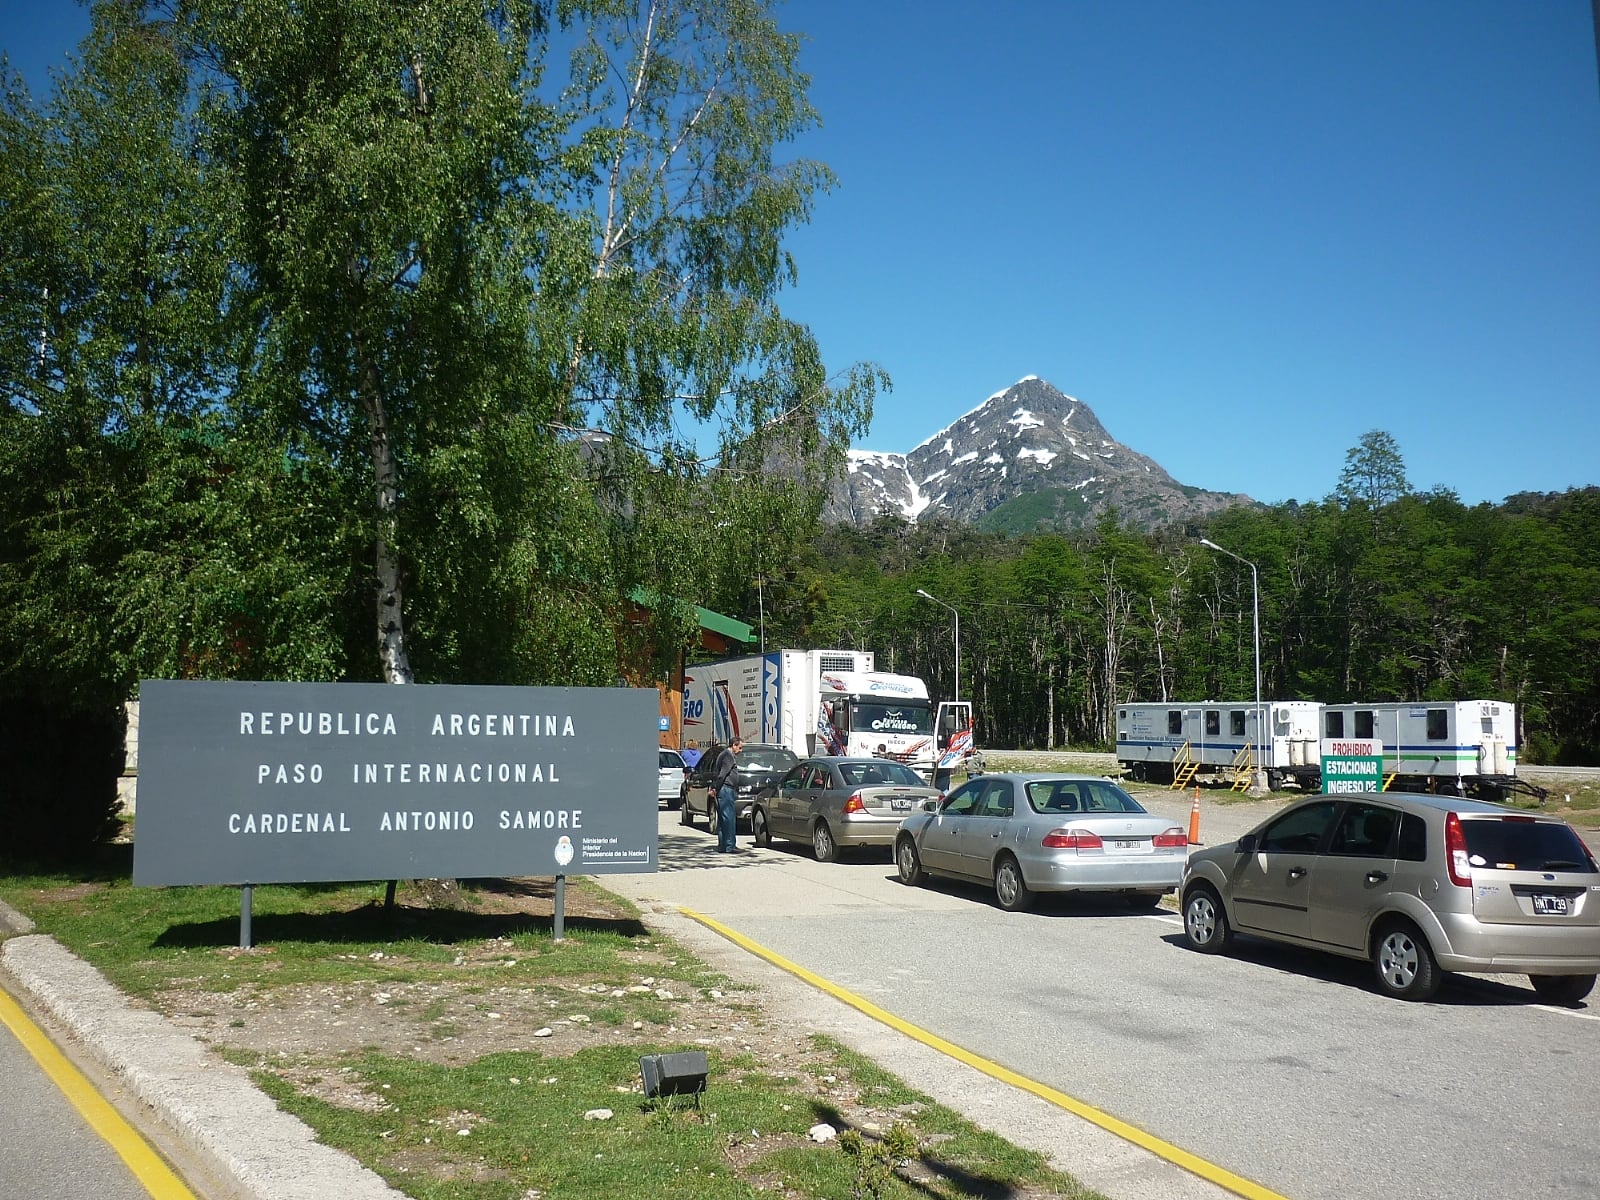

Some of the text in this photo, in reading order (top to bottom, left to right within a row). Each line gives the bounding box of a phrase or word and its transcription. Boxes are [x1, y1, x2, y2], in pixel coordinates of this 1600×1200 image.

[684, 699, 704, 718] GRO
[240, 711, 576, 737] REPUBLICA ARGENTINA
[1332, 743, 1373, 756] PROHIBIDO
[258, 763, 560, 784] PASO INTERNACIONAL
[1326, 760, 1378, 775] ESTACIONAR
[1327, 780, 1364, 794] INGRESO
[228, 809, 583, 834] CARDENAL ANTONIO SAMORE
[1551, 898, 1567, 910] 739
